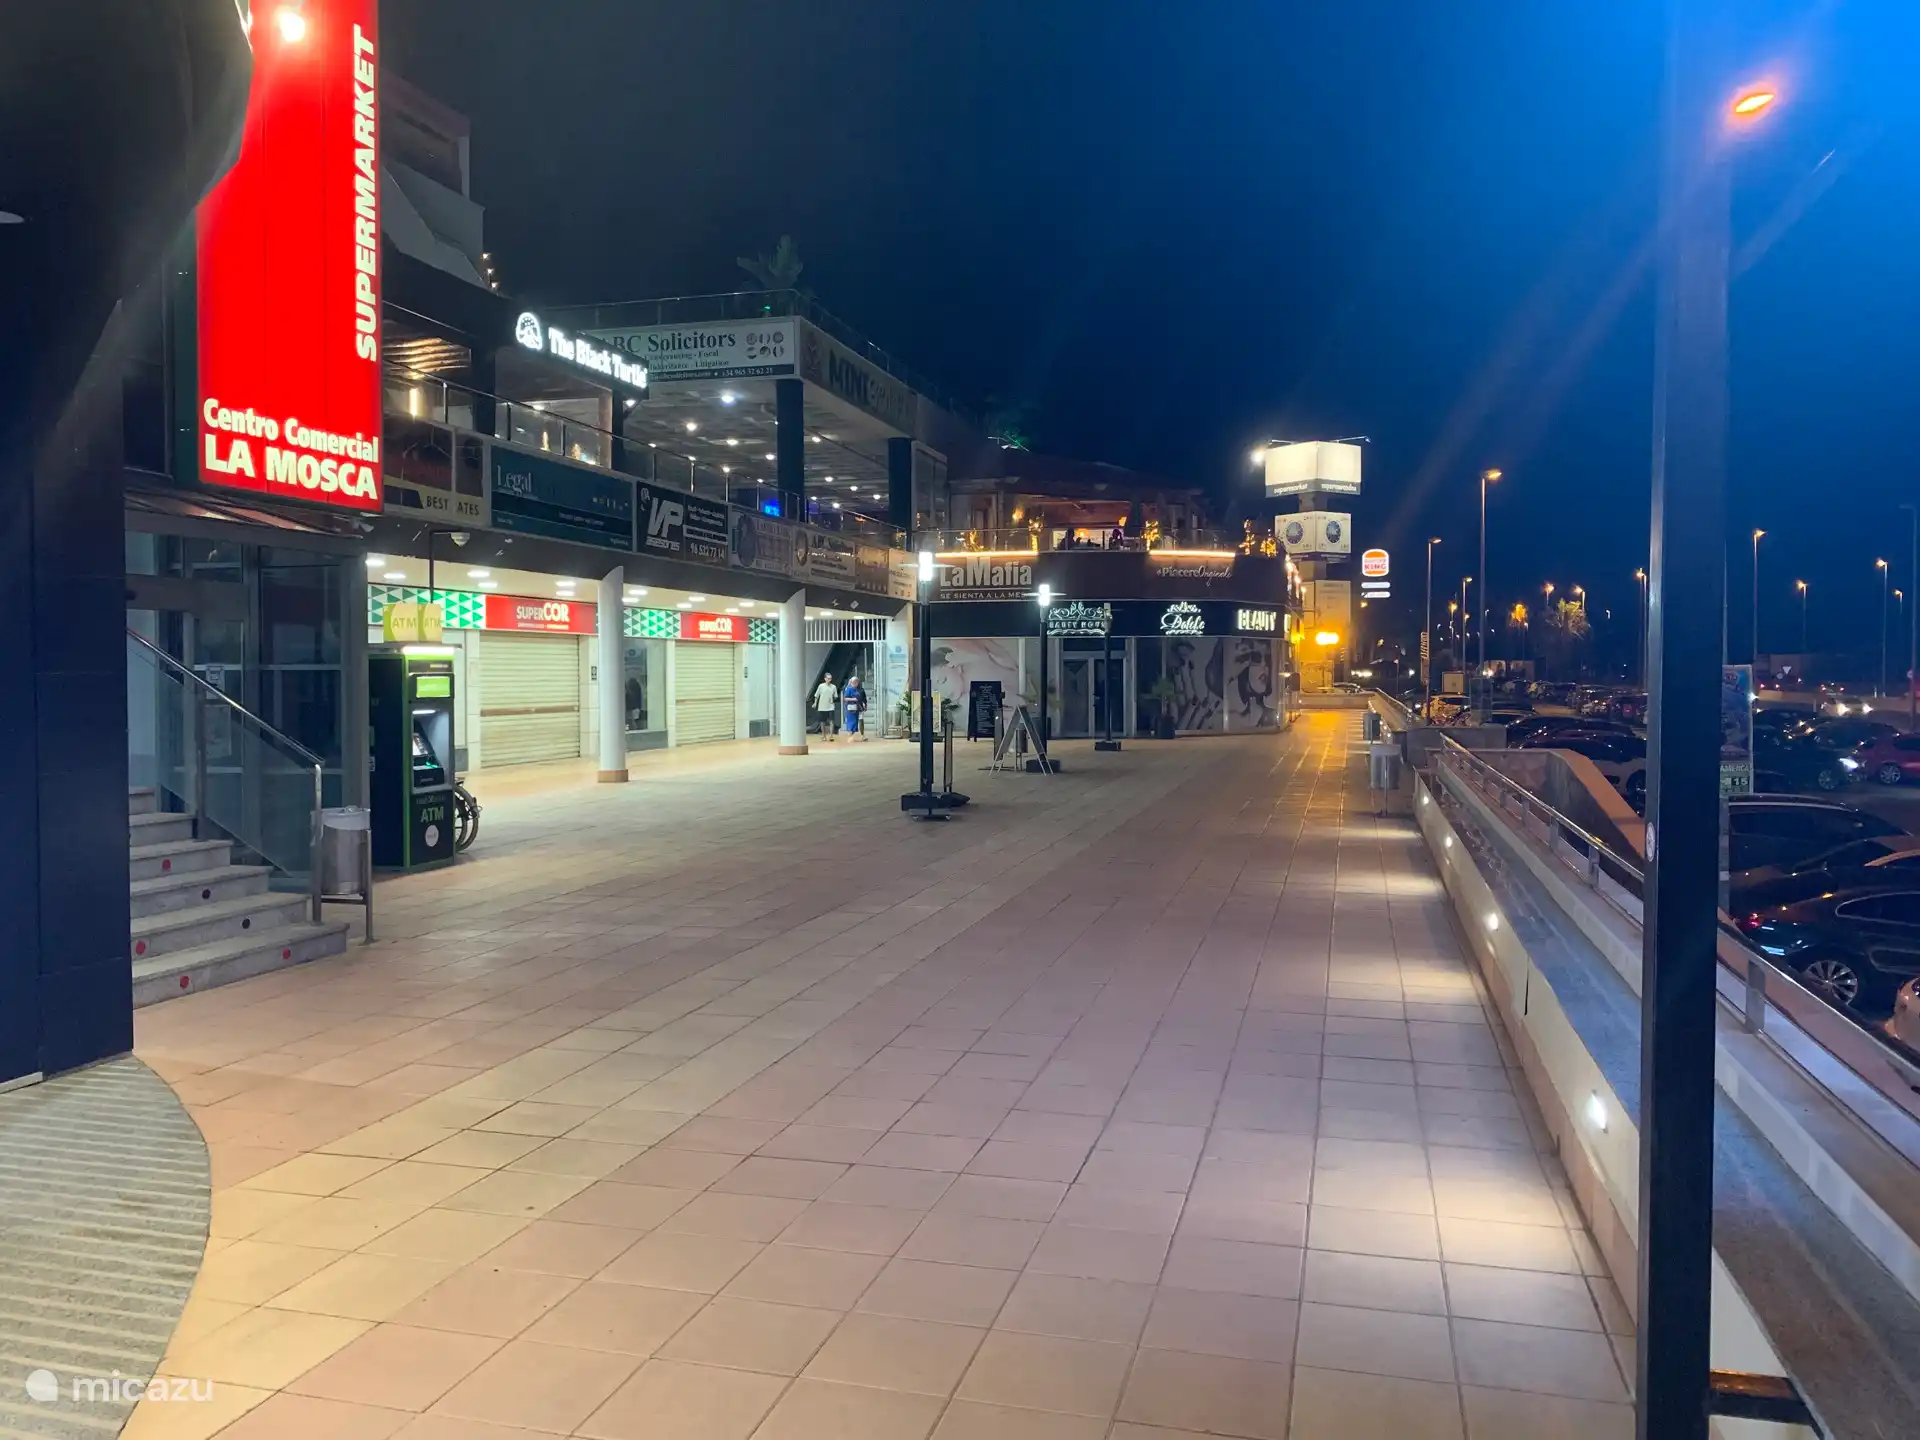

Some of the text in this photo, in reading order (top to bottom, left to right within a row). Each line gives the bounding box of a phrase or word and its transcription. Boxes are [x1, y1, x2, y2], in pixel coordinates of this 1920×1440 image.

[353, 24, 378, 362] SUPERMARKET
[548, 327, 574, 360] The
[648, 331, 736, 352] Solicitors
[698, 350, 719, 358] Fiscal
[203, 398, 379, 463] Centro Comercial
[204, 433, 378, 500] LA MOSCA
[497, 465, 532, 496] Legal
[426, 495, 480, 516] BEST ATES
[392, 617, 417, 628] ATM
[516, 602, 570, 622] SUPERCOR
[420, 806, 444, 823] ATM
